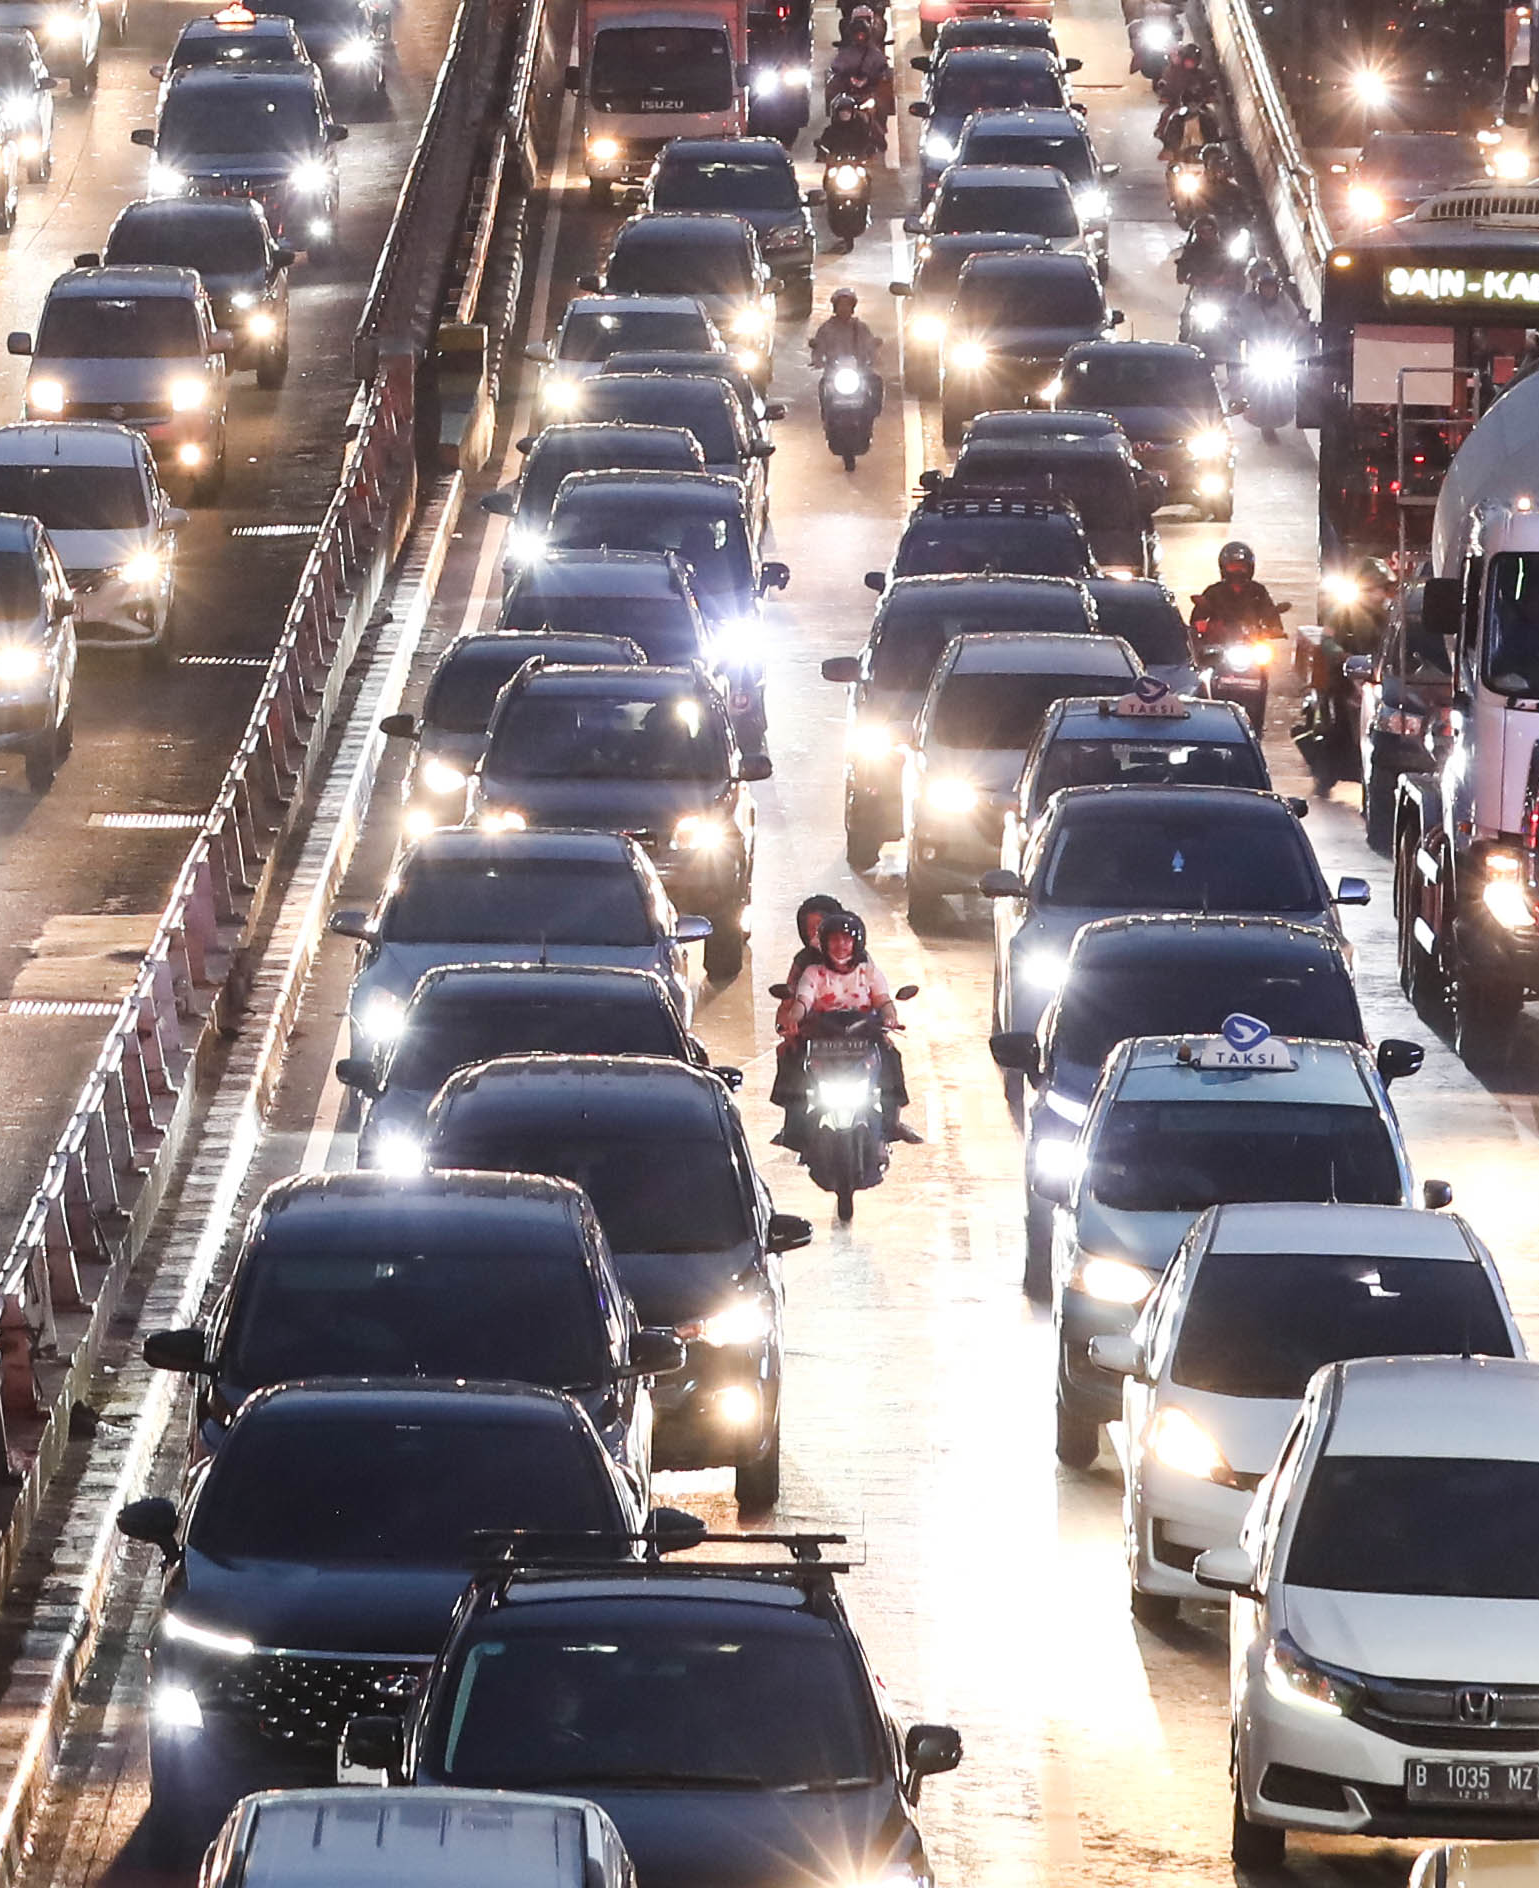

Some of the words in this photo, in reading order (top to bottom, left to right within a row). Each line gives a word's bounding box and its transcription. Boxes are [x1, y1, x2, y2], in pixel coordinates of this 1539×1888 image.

[641, 100, 684, 109] ISUZU
[1129, 703, 1175, 714] TAKSI
[1216, 1052, 1276, 1065] TAKSI
[1416, 1764, 1427, 1787] B
[1447, 1765, 1490, 1789] 1035
[1508, 1767, 1534, 1790] MZ
